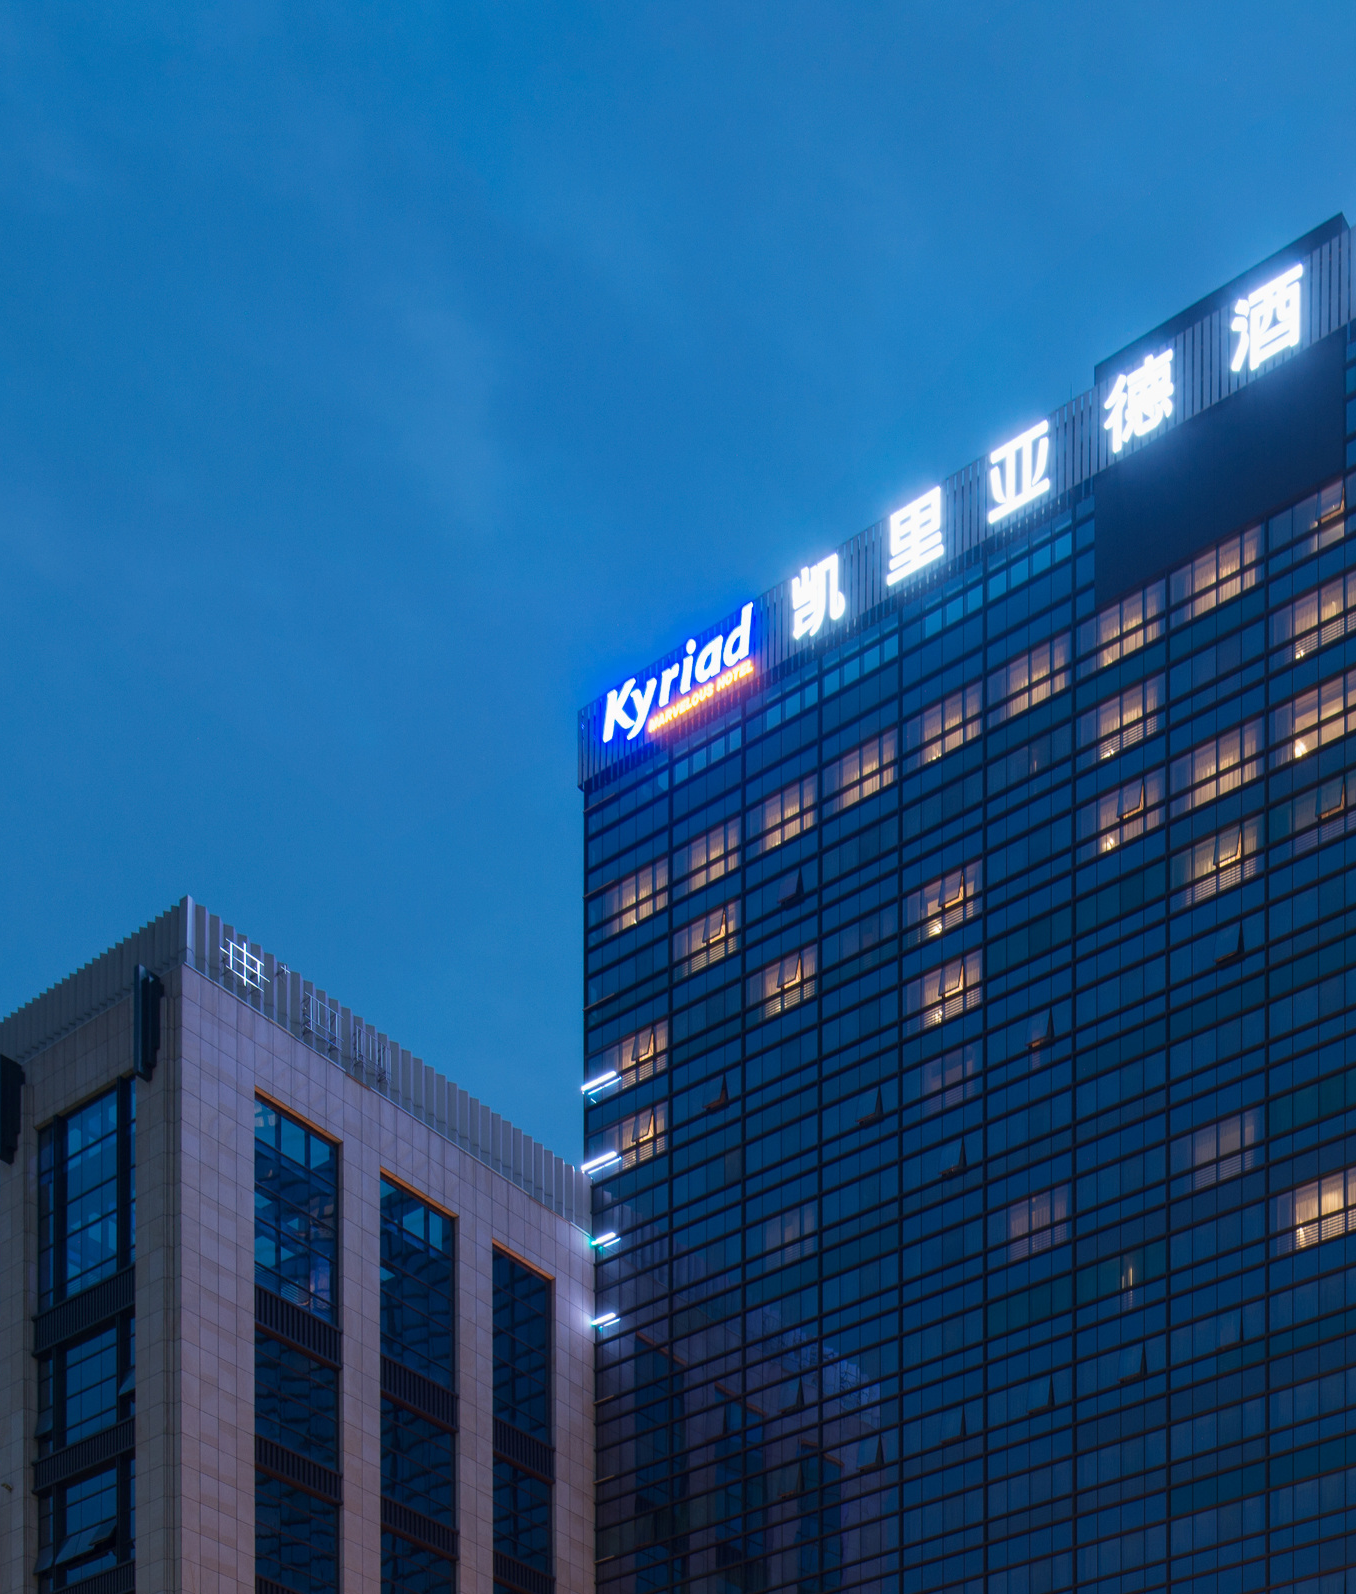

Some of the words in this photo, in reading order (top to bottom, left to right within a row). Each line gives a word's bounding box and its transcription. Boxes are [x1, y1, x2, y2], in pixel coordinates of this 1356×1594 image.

[603, 601, 754, 743] Kyriad
[648, 682, 715, 733] MARVELOUS
[716, 659, 754, 691] HOTEL
